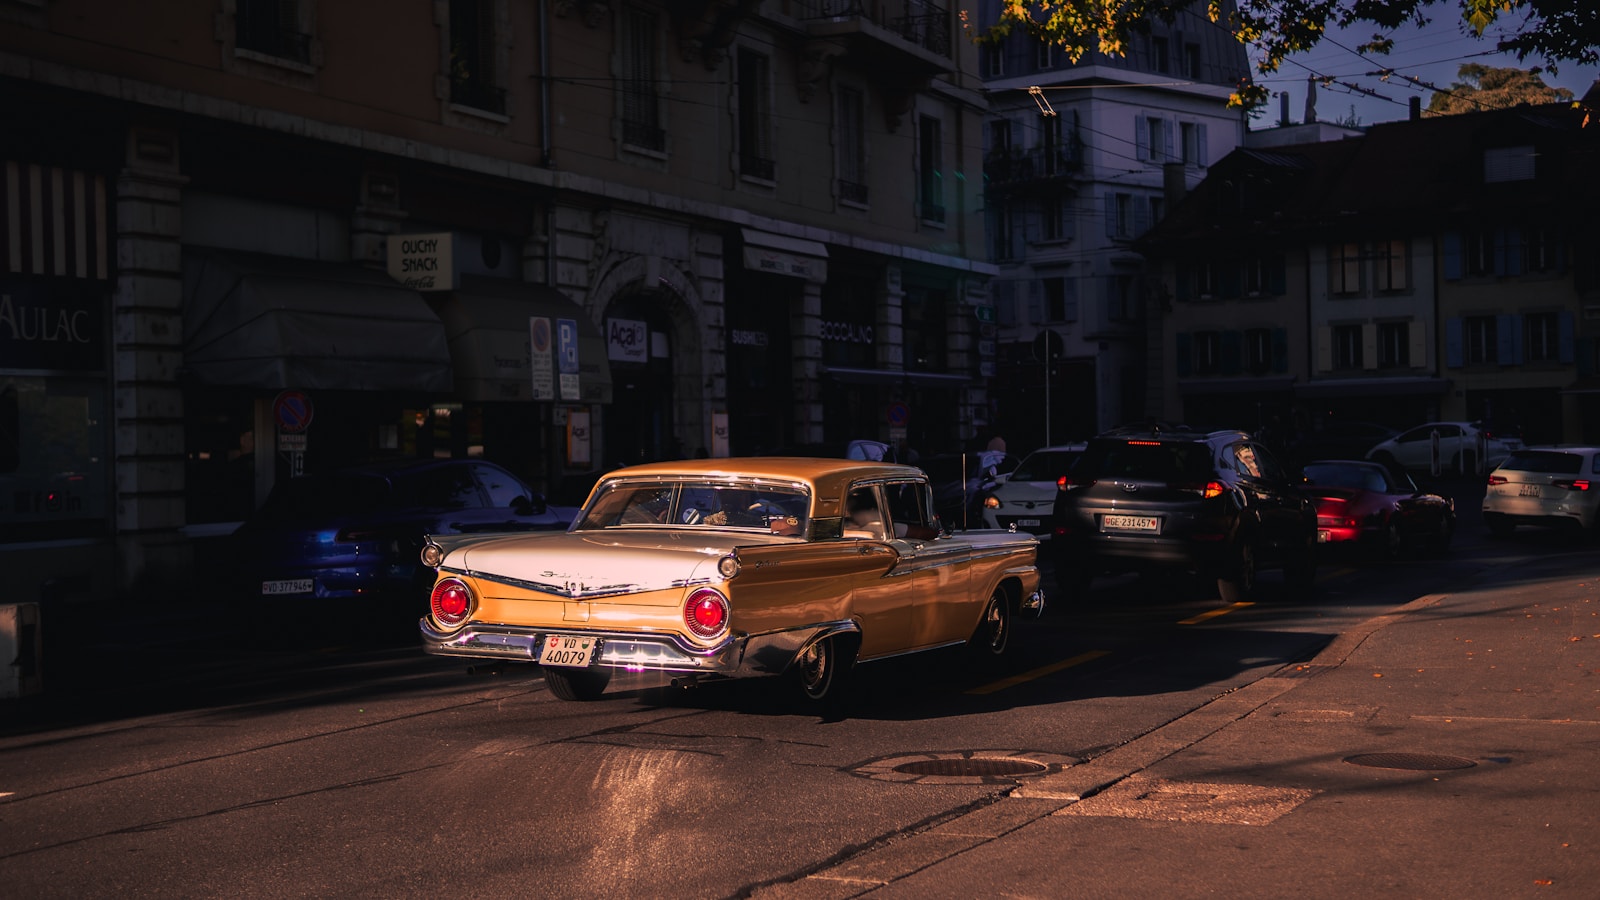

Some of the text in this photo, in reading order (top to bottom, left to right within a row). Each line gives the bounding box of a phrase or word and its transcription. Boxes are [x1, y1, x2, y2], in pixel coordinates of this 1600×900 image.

[402, 240, 438, 254] OUCHY
[402, 257, 438, 272] SNACK
[0, 294, 90, 343] AULAC
[561, 324, 571, 352] P
[1122, 518, 1151, 528] 231457
[279, 581, 307, 592] 377946
[563, 638, 577, 649] VD
[546, 650, 585, 665] 40079
